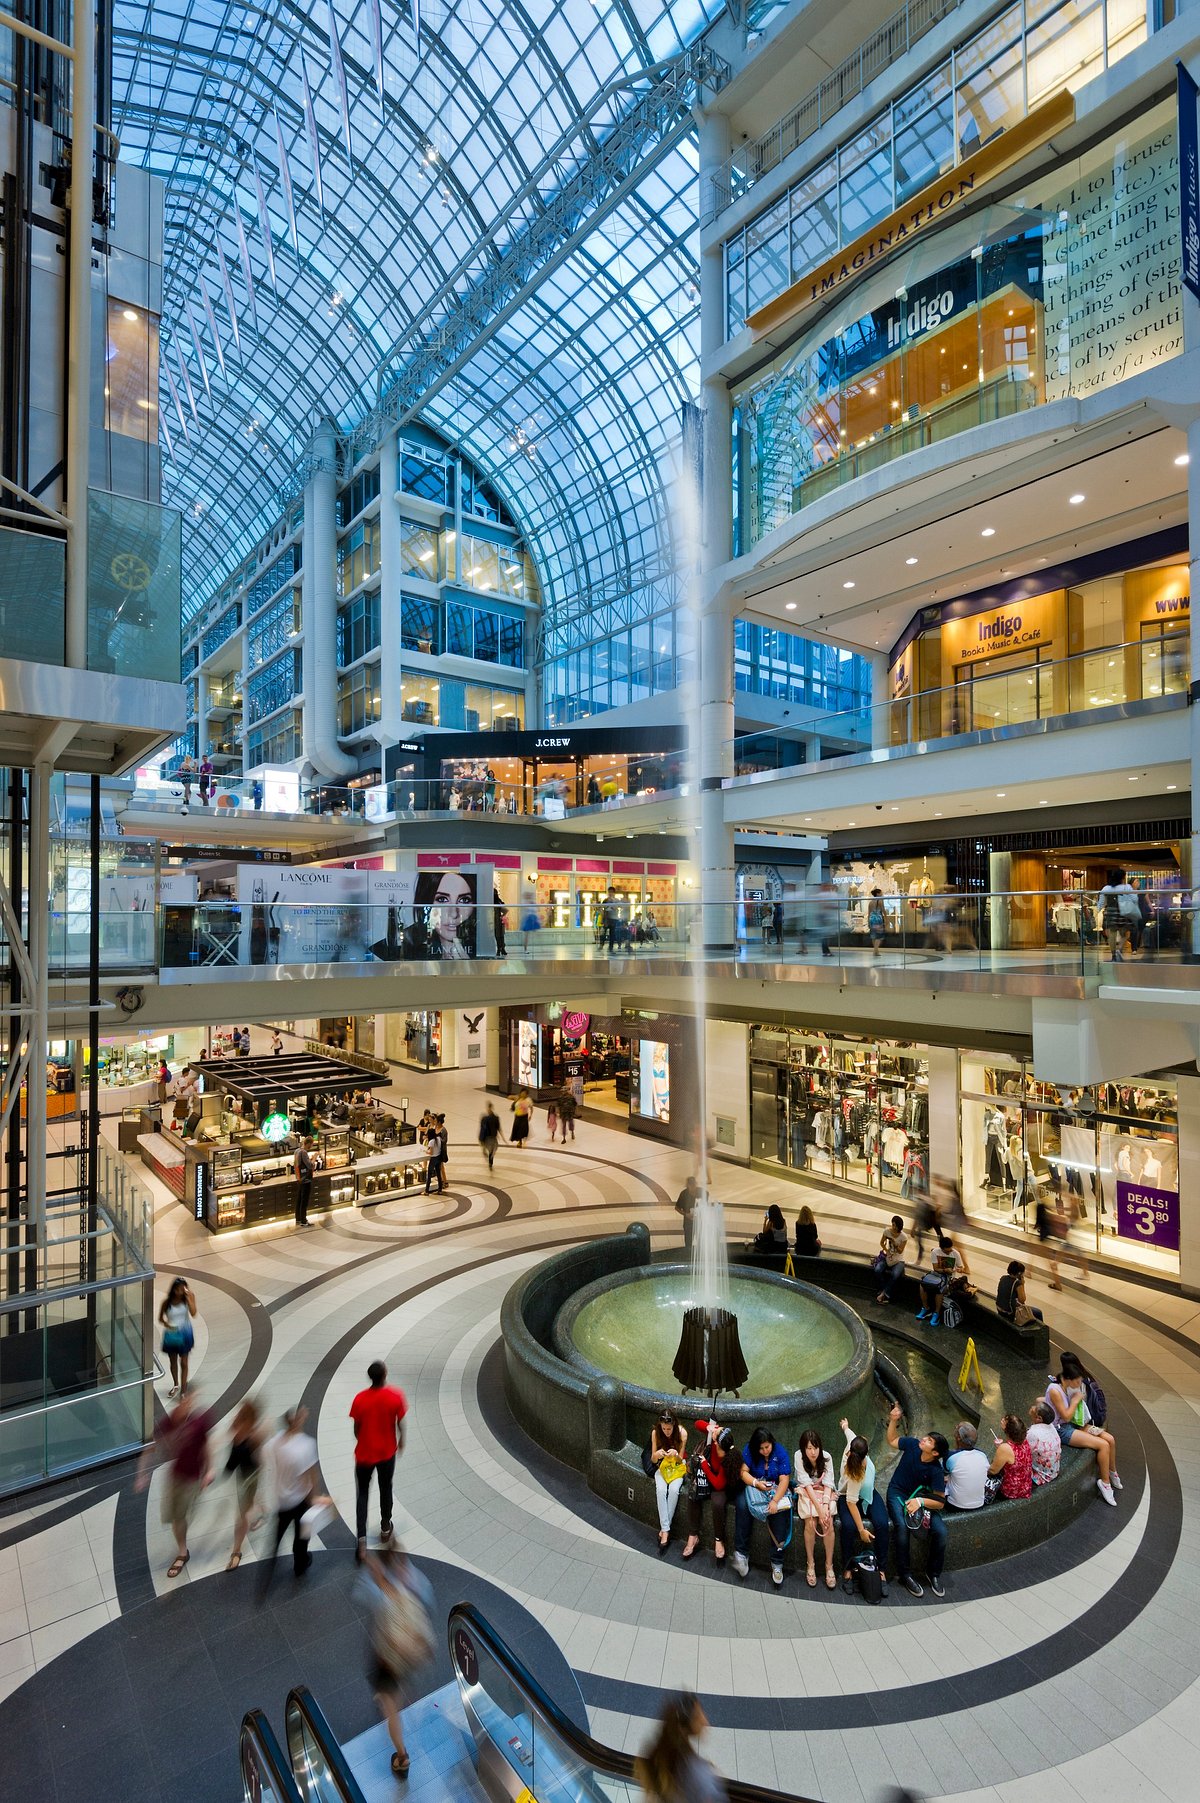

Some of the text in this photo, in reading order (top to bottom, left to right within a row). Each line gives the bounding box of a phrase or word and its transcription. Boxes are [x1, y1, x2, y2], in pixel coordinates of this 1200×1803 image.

[1088, 177, 1105, 193] to
[1111, 132, 1173, 186] peruse
[1114, 165, 1162, 201] etc.):
[810, 172, 976, 301] IMAGINATION
[1055, 194, 1158, 264] (something
[1070, 247, 1108, 277] have
[1114, 216, 1157, 252] such
[1061, 268, 1114, 306] things
[1119, 231, 1181, 273] writte
[1119, 272, 1140, 298] of
[1045, 341, 1060, 362] by
[1070, 311, 1126, 348] means
[1132, 290, 1153, 317] of
[1075, 345, 1093, 369] of
[1098, 338, 1118, 361] by
[1061, 370, 1107, 399] threat
[1113, 352, 1133, 382] of
[1134, 353, 1144, 368] a
[978, 614, 1023, 642] Indigo
[961, 629, 1041, 659] Books Music & Café
[535, 737, 571, 748] J.CREW
[280, 872, 334, 884] LANCÔME
[1127, 1192, 1169, 1210] DEALS!
[458, 1634, 475, 1662] Level
[463, 1655, 470, 1677] 1
